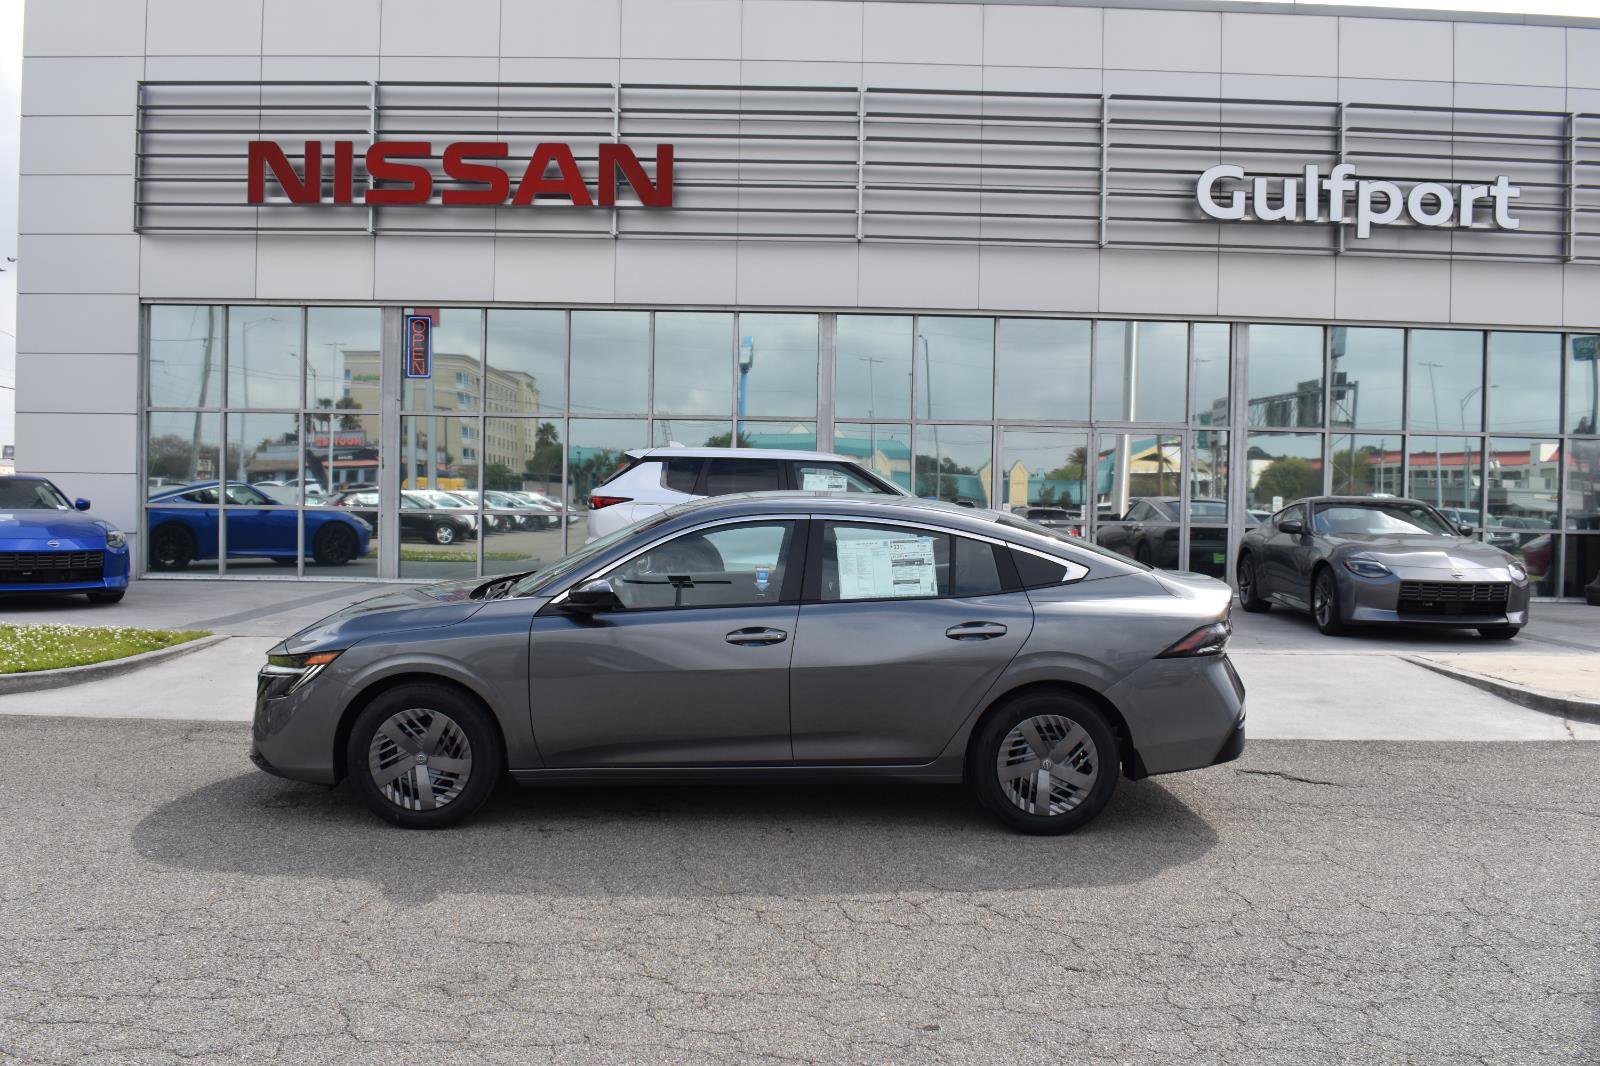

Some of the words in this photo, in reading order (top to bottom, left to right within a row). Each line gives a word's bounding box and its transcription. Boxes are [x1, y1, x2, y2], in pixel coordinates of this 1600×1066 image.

[248, 141, 674, 207] NISSAN
[1196, 163, 1521, 239] Gulfport
[412, 319, 426, 375] OPEN
